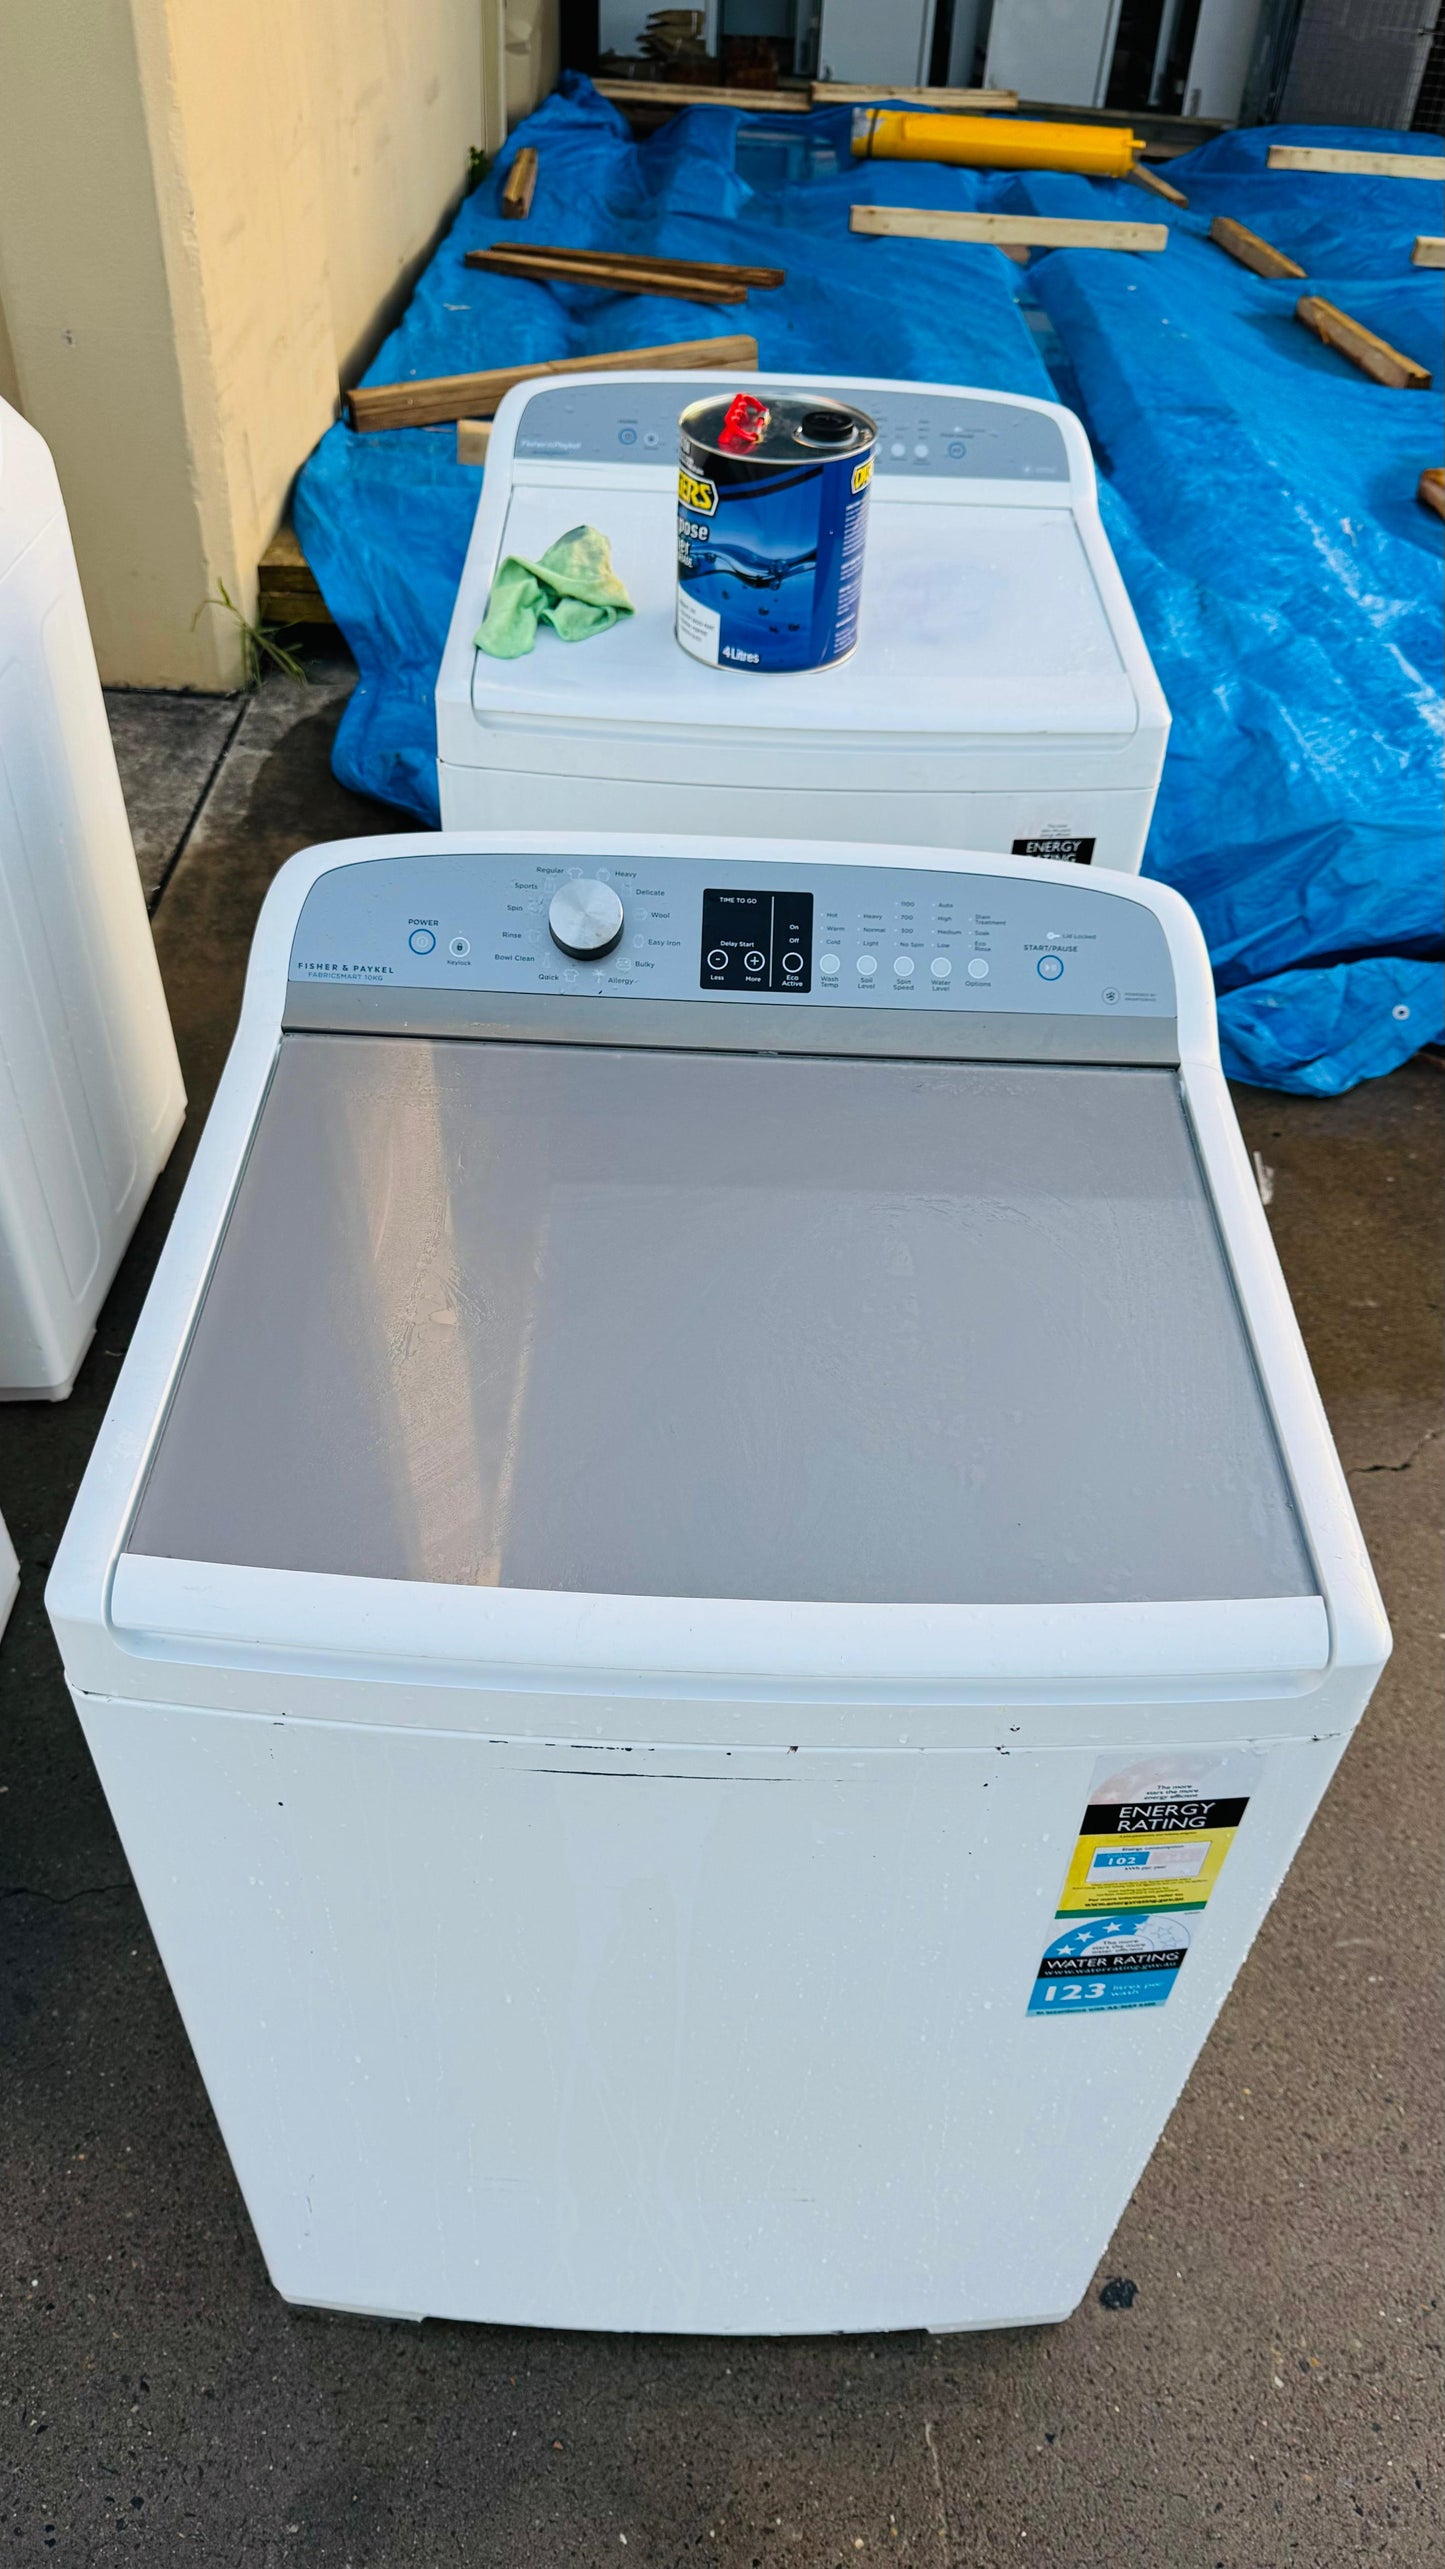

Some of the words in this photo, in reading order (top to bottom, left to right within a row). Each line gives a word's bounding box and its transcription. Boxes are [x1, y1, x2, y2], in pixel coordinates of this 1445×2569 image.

[1026, 840, 1082, 853] ENERGY
[536, 867, 564, 875] Regular
[615, 871, 637, 879] Heavy
[514, 882, 538, 890] Sports
[635, 889, 665, 897] Delicate
[507, 904, 523, 912] Spin
[408, 919, 439, 927] POWER
[648, 939, 665, 947] Easy
[720, 940, 738, 948] Delay
[1023, 944, 1078, 952] START/PAUSE
[514, 954, 535, 962] Clean
[298, 962, 338, 972] FISHER
[342, 964, 349, 972] &
[353, 965, 394, 974] PAYKEL
[635, 961, 655, 969] Bulky
[308, 972, 362, 981] FABRICSMART
[538, 973, 559, 981] Quick
[608, 977, 634, 985] Allergy
[896, 978, 911, 986] Spin
[965, 980, 991, 988] Options
[1119, 1802, 1215, 1818] ENERGY
[1117, 1816, 1207, 1832] RATING
[1108, 1857, 1136, 1865] 102
[1047, 1957, 1108, 1969] WATER
[1113, 1952, 1179, 1967] RATING
[1045, 1983, 1106, 2001] 123
